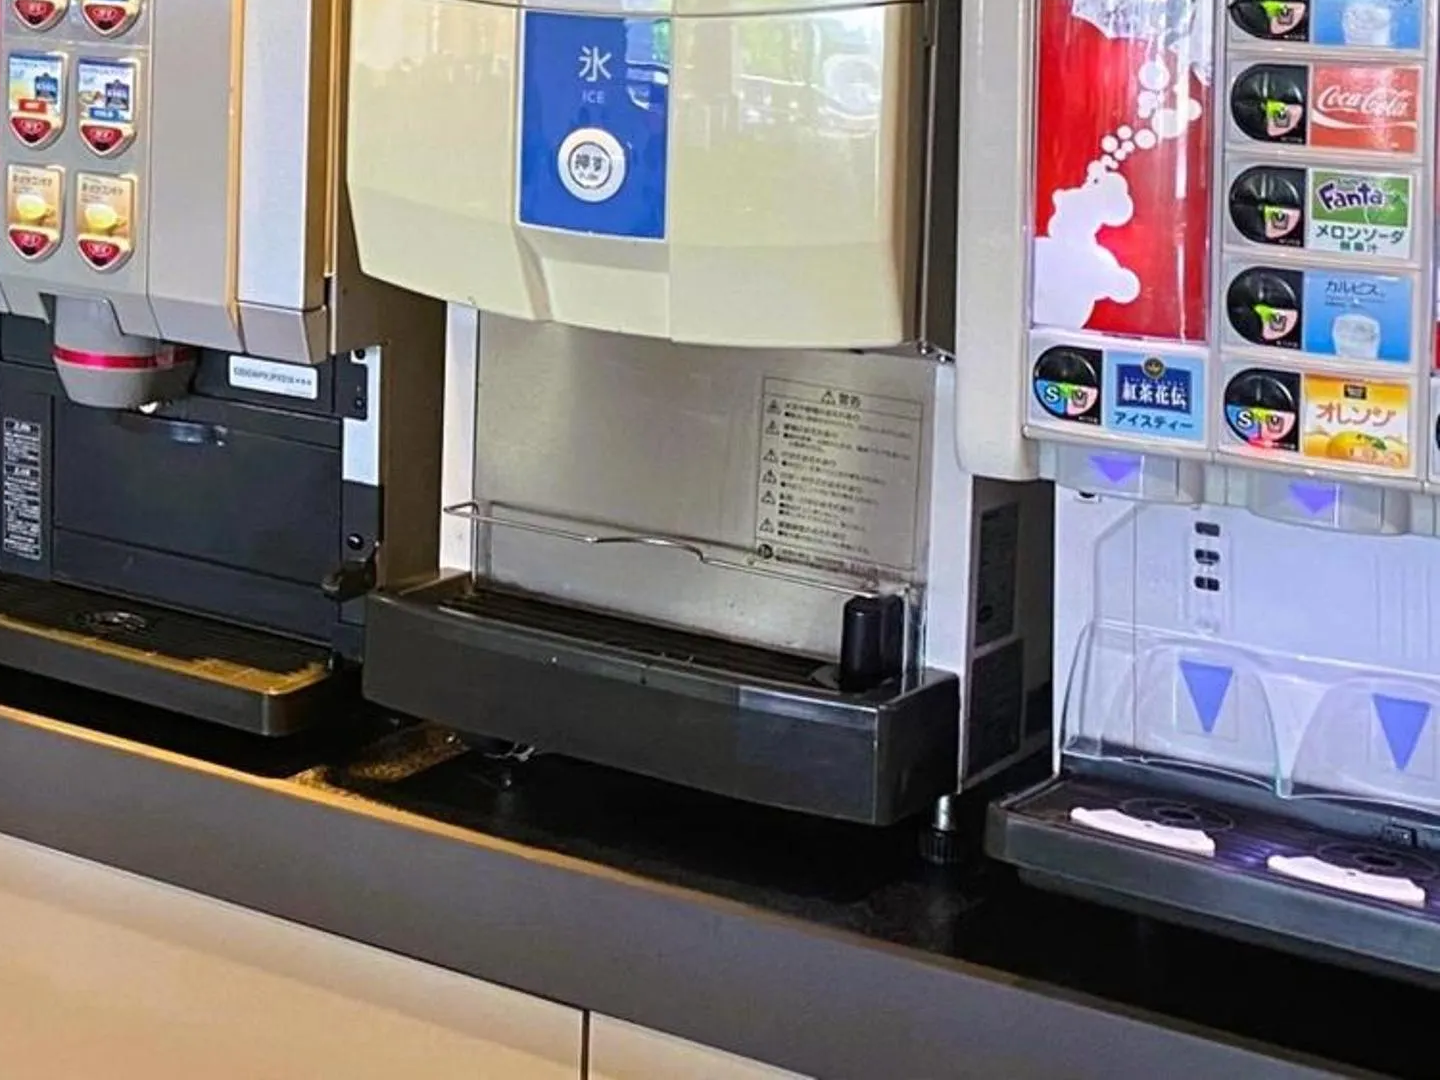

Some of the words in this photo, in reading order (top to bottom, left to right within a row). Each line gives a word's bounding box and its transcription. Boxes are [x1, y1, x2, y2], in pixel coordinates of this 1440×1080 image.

[578, 45, 613, 82] 氷
[582, 90, 605, 104] ICE
[1316, 84, 1412, 119] Coca-Cola
[574, 153, 605, 171] 押す
[1318, 182, 1385, 210] Fanta
[1315, 224, 1405, 244] メロンソーダ
[1324, 280, 1382, 296] カルピス
[1045, 386, 1060, 403] S
[1121, 377, 1187, 409] 紅茶花伝
[1114, 411, 1194, 431] アイスティー
[1238, 411, 1252, 428] S
[1316, 402, 1397, 427] オレンジ
